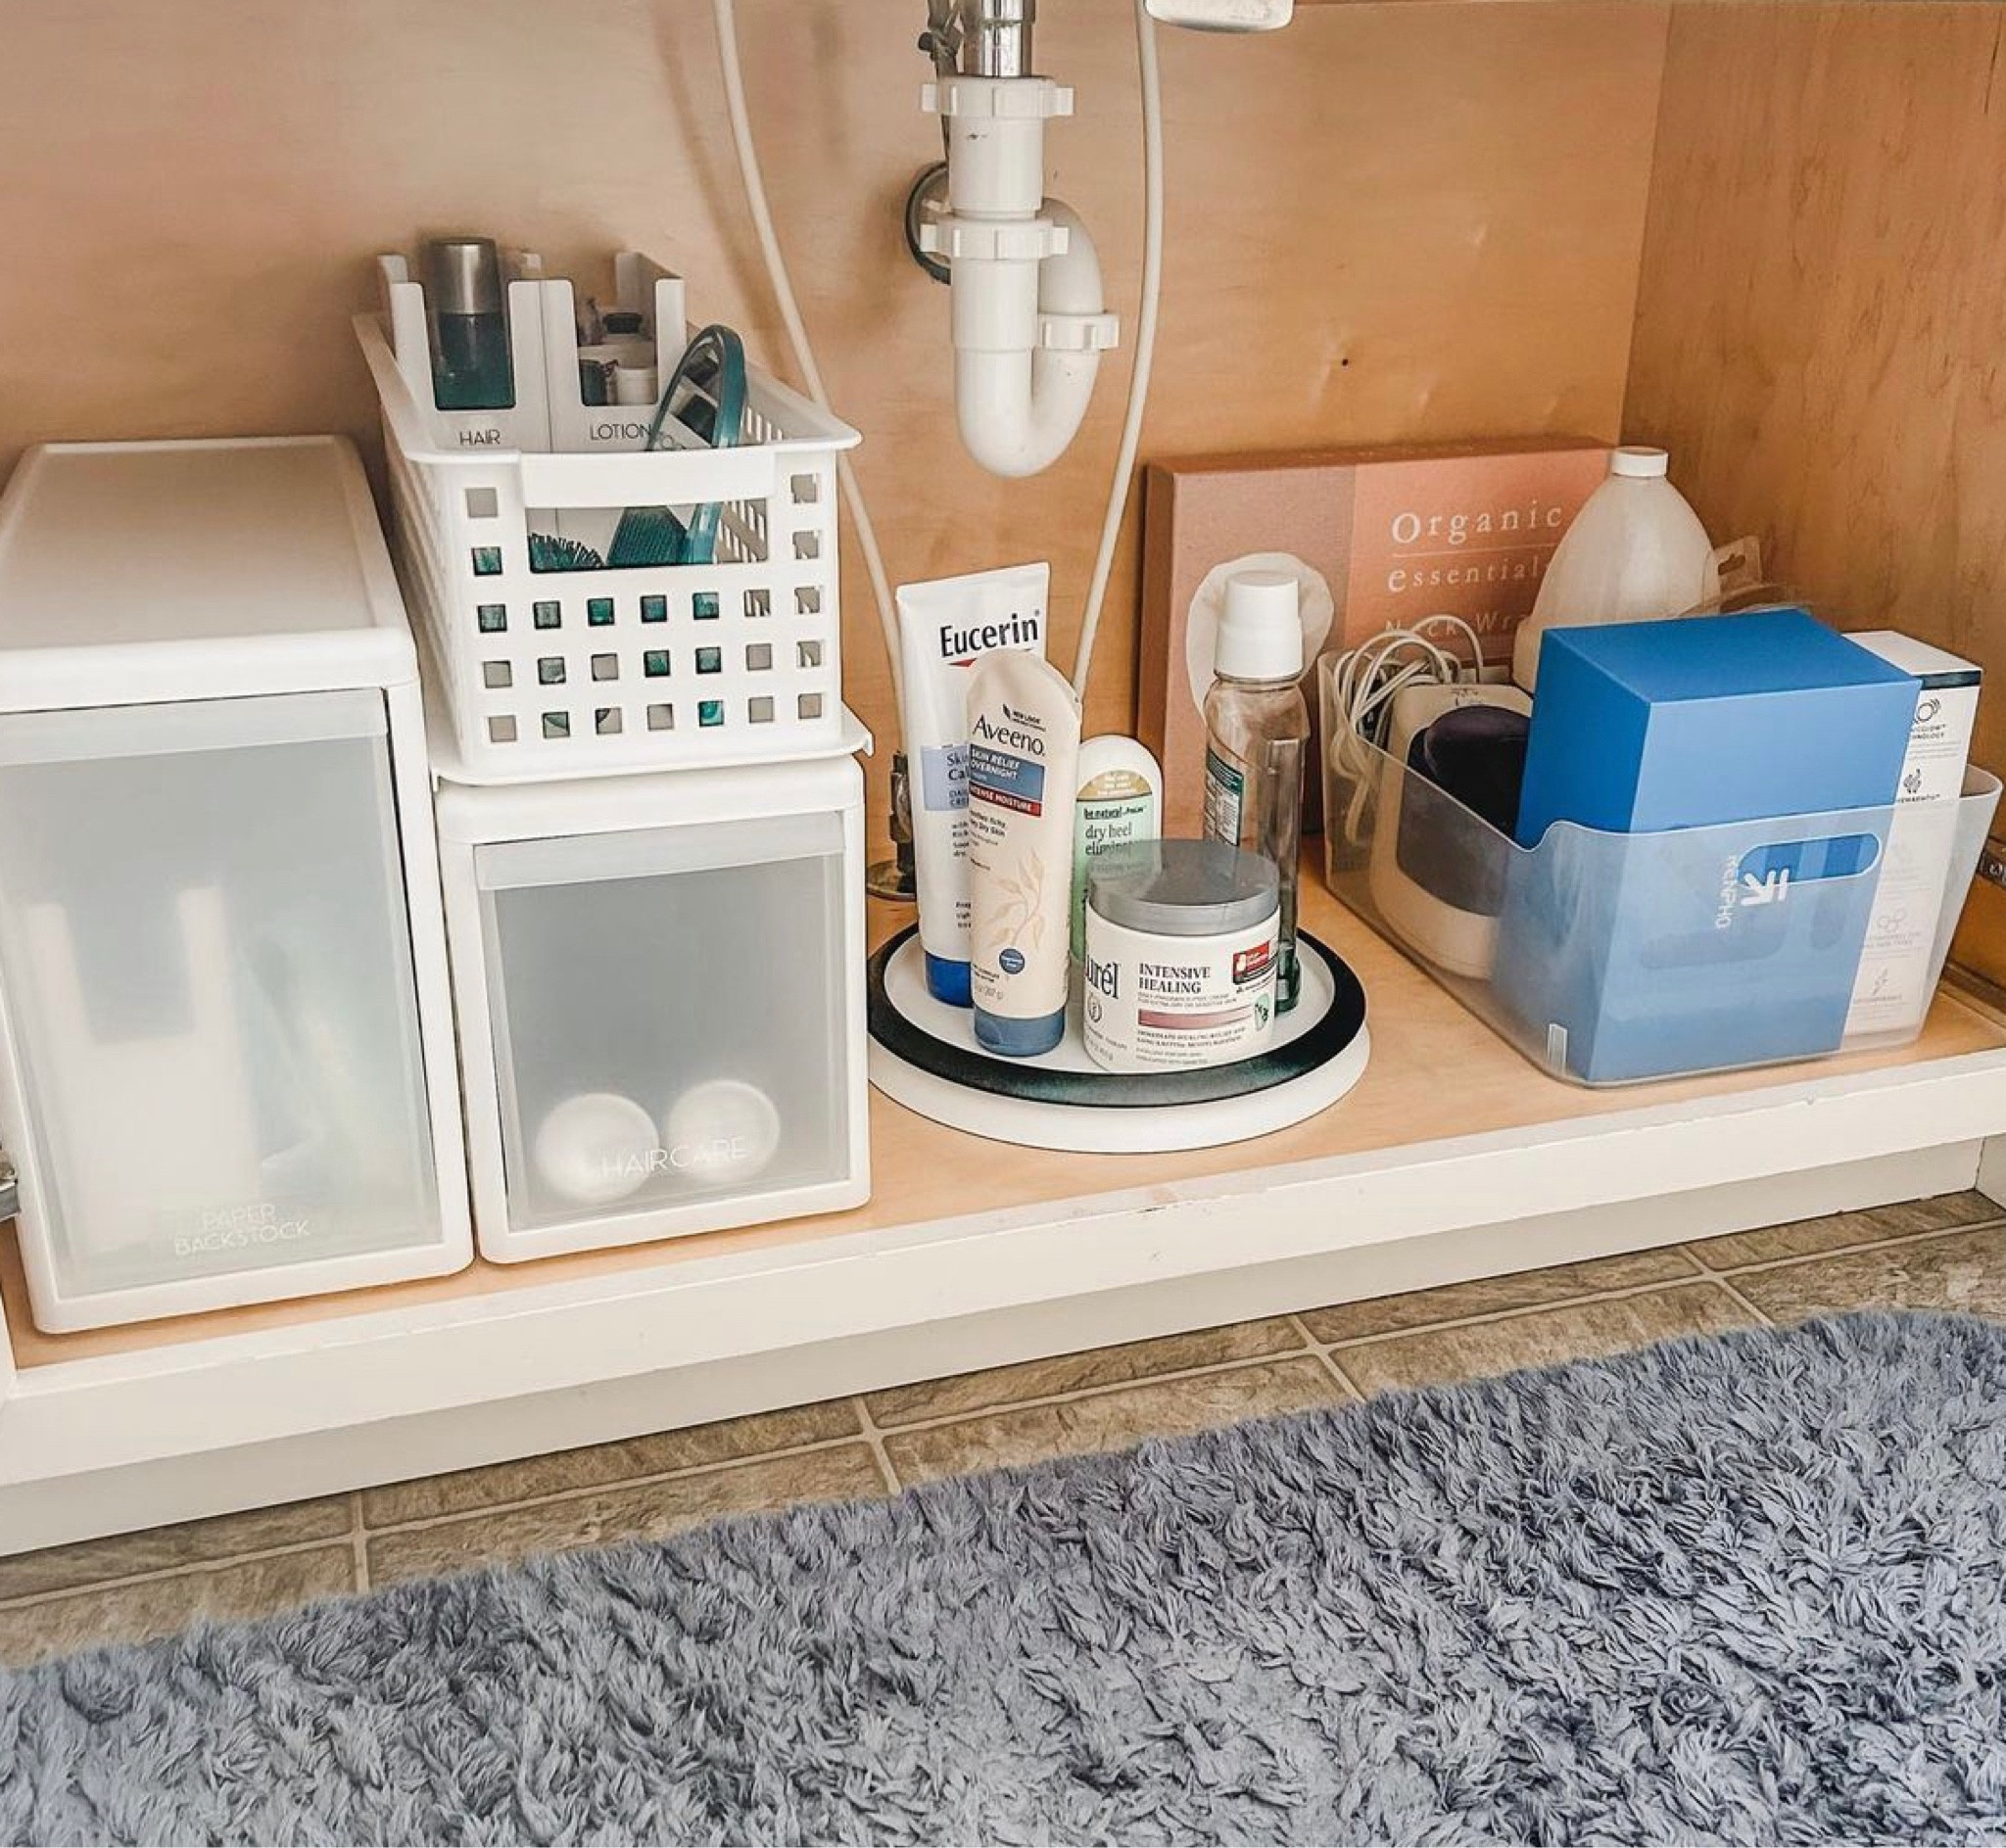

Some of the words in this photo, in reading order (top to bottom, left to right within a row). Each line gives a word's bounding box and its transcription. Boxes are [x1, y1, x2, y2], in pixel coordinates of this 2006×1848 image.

[459, 428, 501, 446] HAIR
[590, 423, 653, 441] LOTION
[1391, 500, 1561, 545] Organic
[1388, 556, 1541, 592] essential
[939, 613, 1038, 658] Eucerin
[1385, 618, 1457, 638] Nck
[973, 714, 1045, 756] Aveeno
[971, 759, 1019, 781] OVERNIGHT
[990, 753, 1020, 769] RELIEF
[1085, 825, 1107, 842] dry
[1109, 822, 1132, 839] heel
[1086, 954, 1120, 1000] urél
[1139, 963, 1211, 979] INTENSIVE
[1139, 977, 1202, 994] HEALING
[601, 1136, 751, 1178] HAIRCARE
[203, 1204, 275, 1230] PAPER
[174, 1219, 310, 1256] BACKSTOCK
